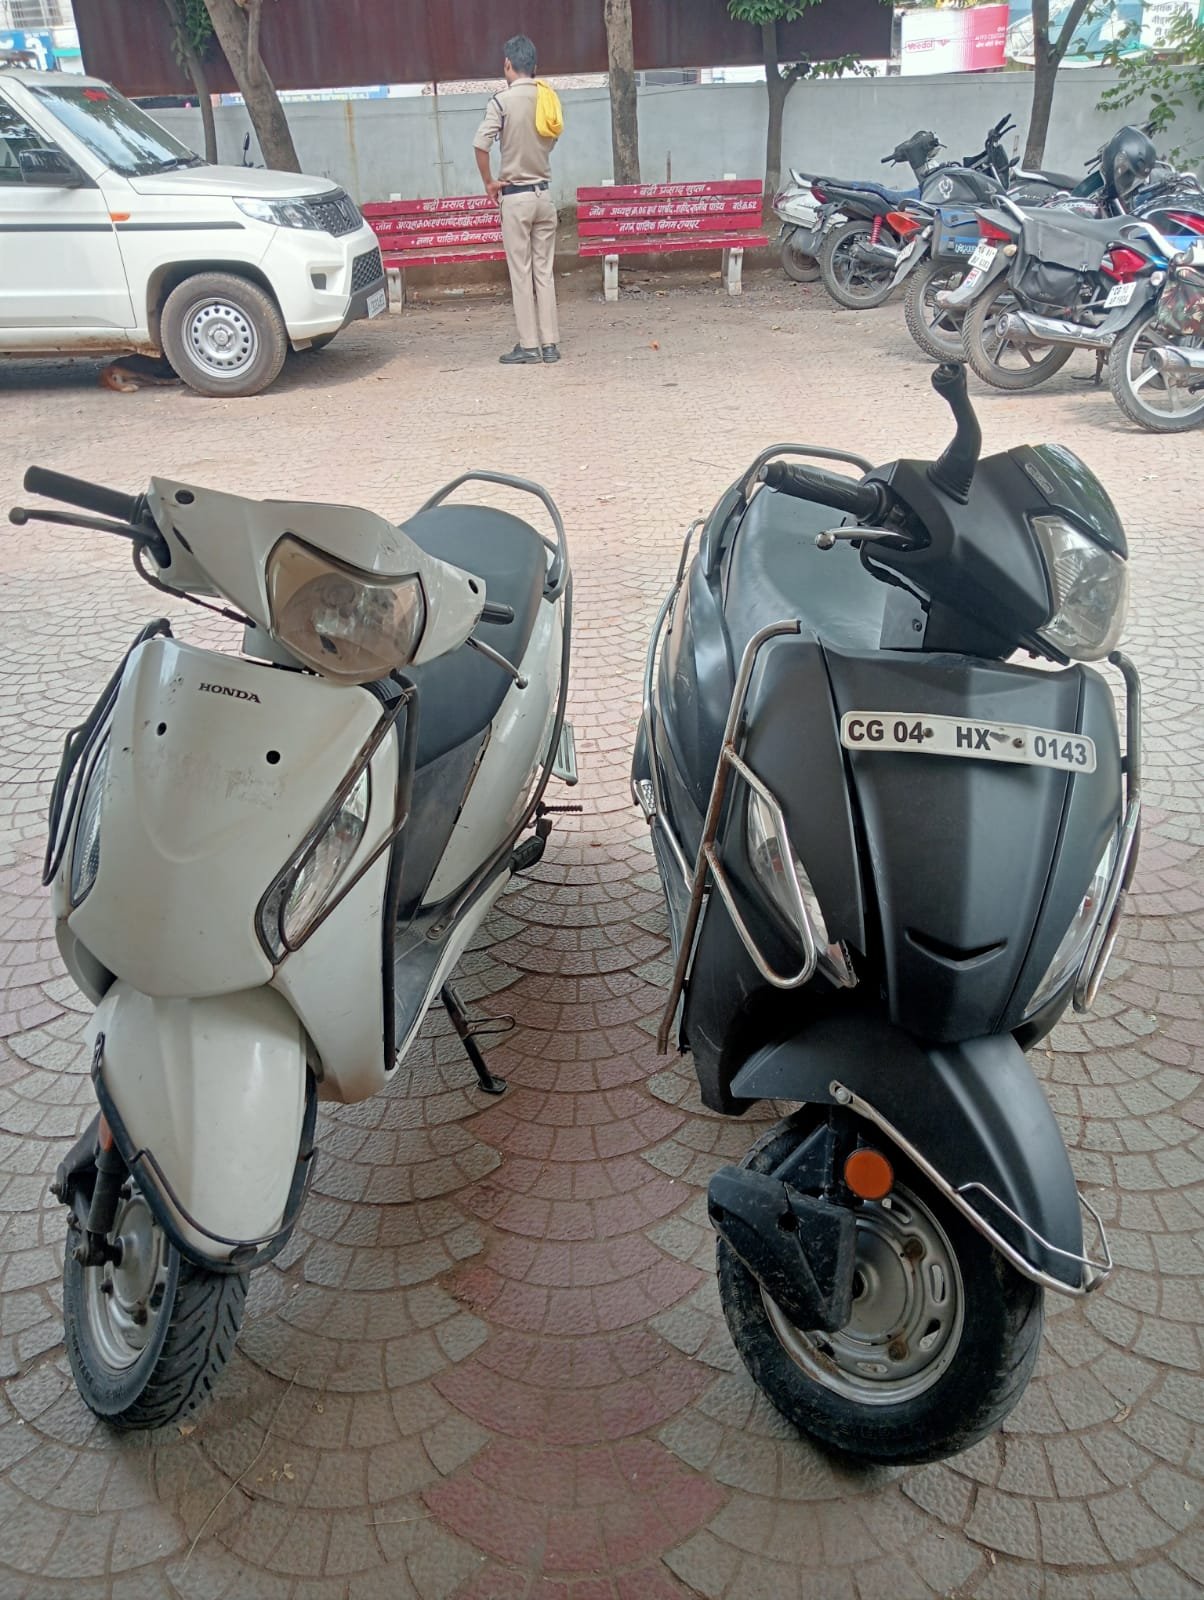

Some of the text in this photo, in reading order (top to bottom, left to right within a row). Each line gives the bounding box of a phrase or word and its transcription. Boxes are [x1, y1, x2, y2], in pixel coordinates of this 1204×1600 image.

[659, 185, 684, 197] प्रसाद
[441, 199, 465, 210] प्रसाद
[198, 682, 262, 704] HONDA
[847, 719, 1088, 766] CG 04 HX 0143
